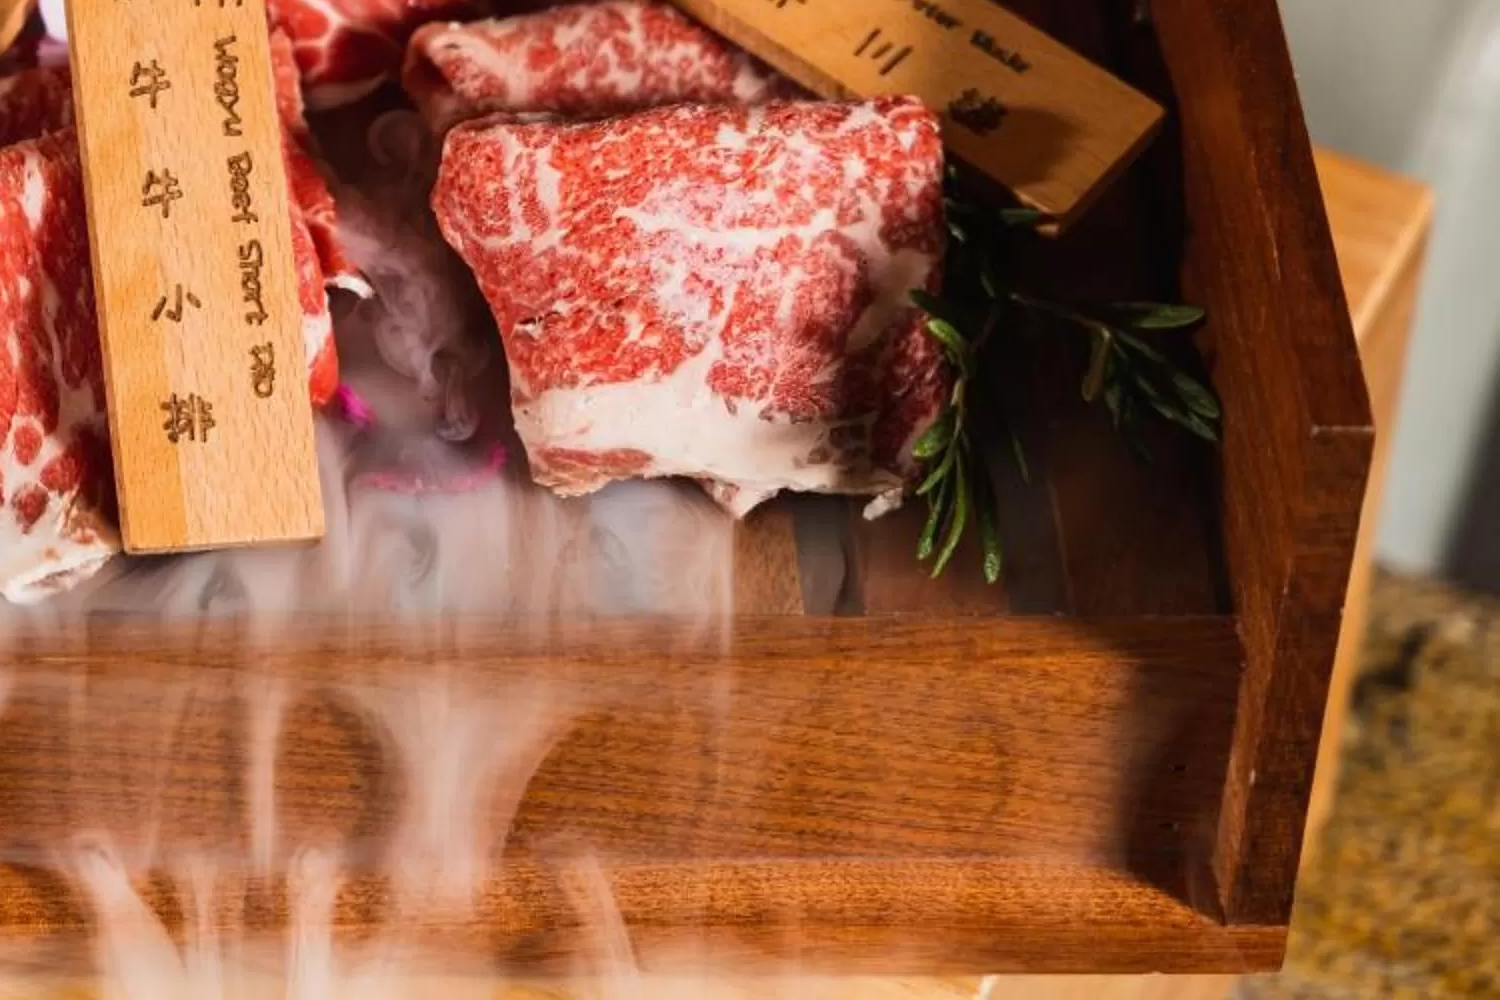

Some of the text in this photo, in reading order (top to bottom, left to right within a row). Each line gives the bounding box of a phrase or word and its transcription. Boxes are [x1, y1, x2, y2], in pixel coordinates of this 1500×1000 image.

[213, 34, 243, 137] Wagyu
[228, 150, 260, 225] Beef
[238, 239, 270, 327] Short
